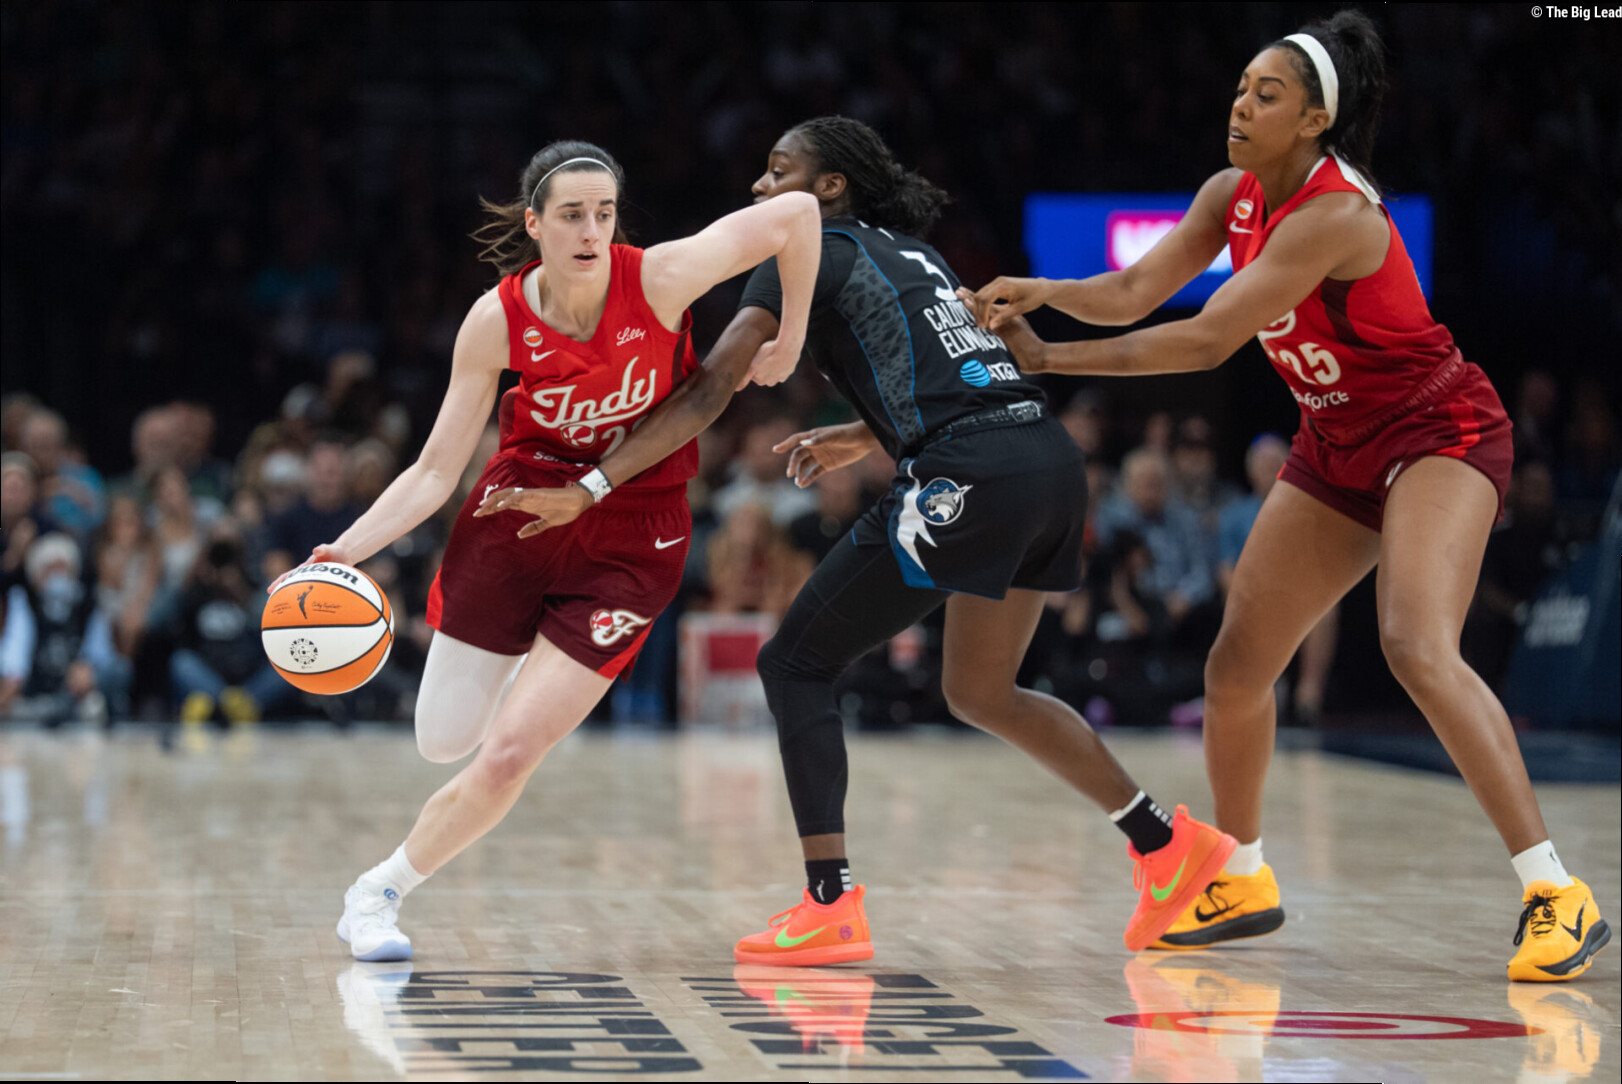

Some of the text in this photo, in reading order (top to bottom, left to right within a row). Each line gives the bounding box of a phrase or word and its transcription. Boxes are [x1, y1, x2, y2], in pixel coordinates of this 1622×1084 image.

[616, 326, 646, 346] Lilly
[1278, 342, 1341, 385] 25
[530, 356, 656, 430] Indy
[386, 970, 703, 1073] CENTER
[681, 973, 1091, 1078] TARGET
